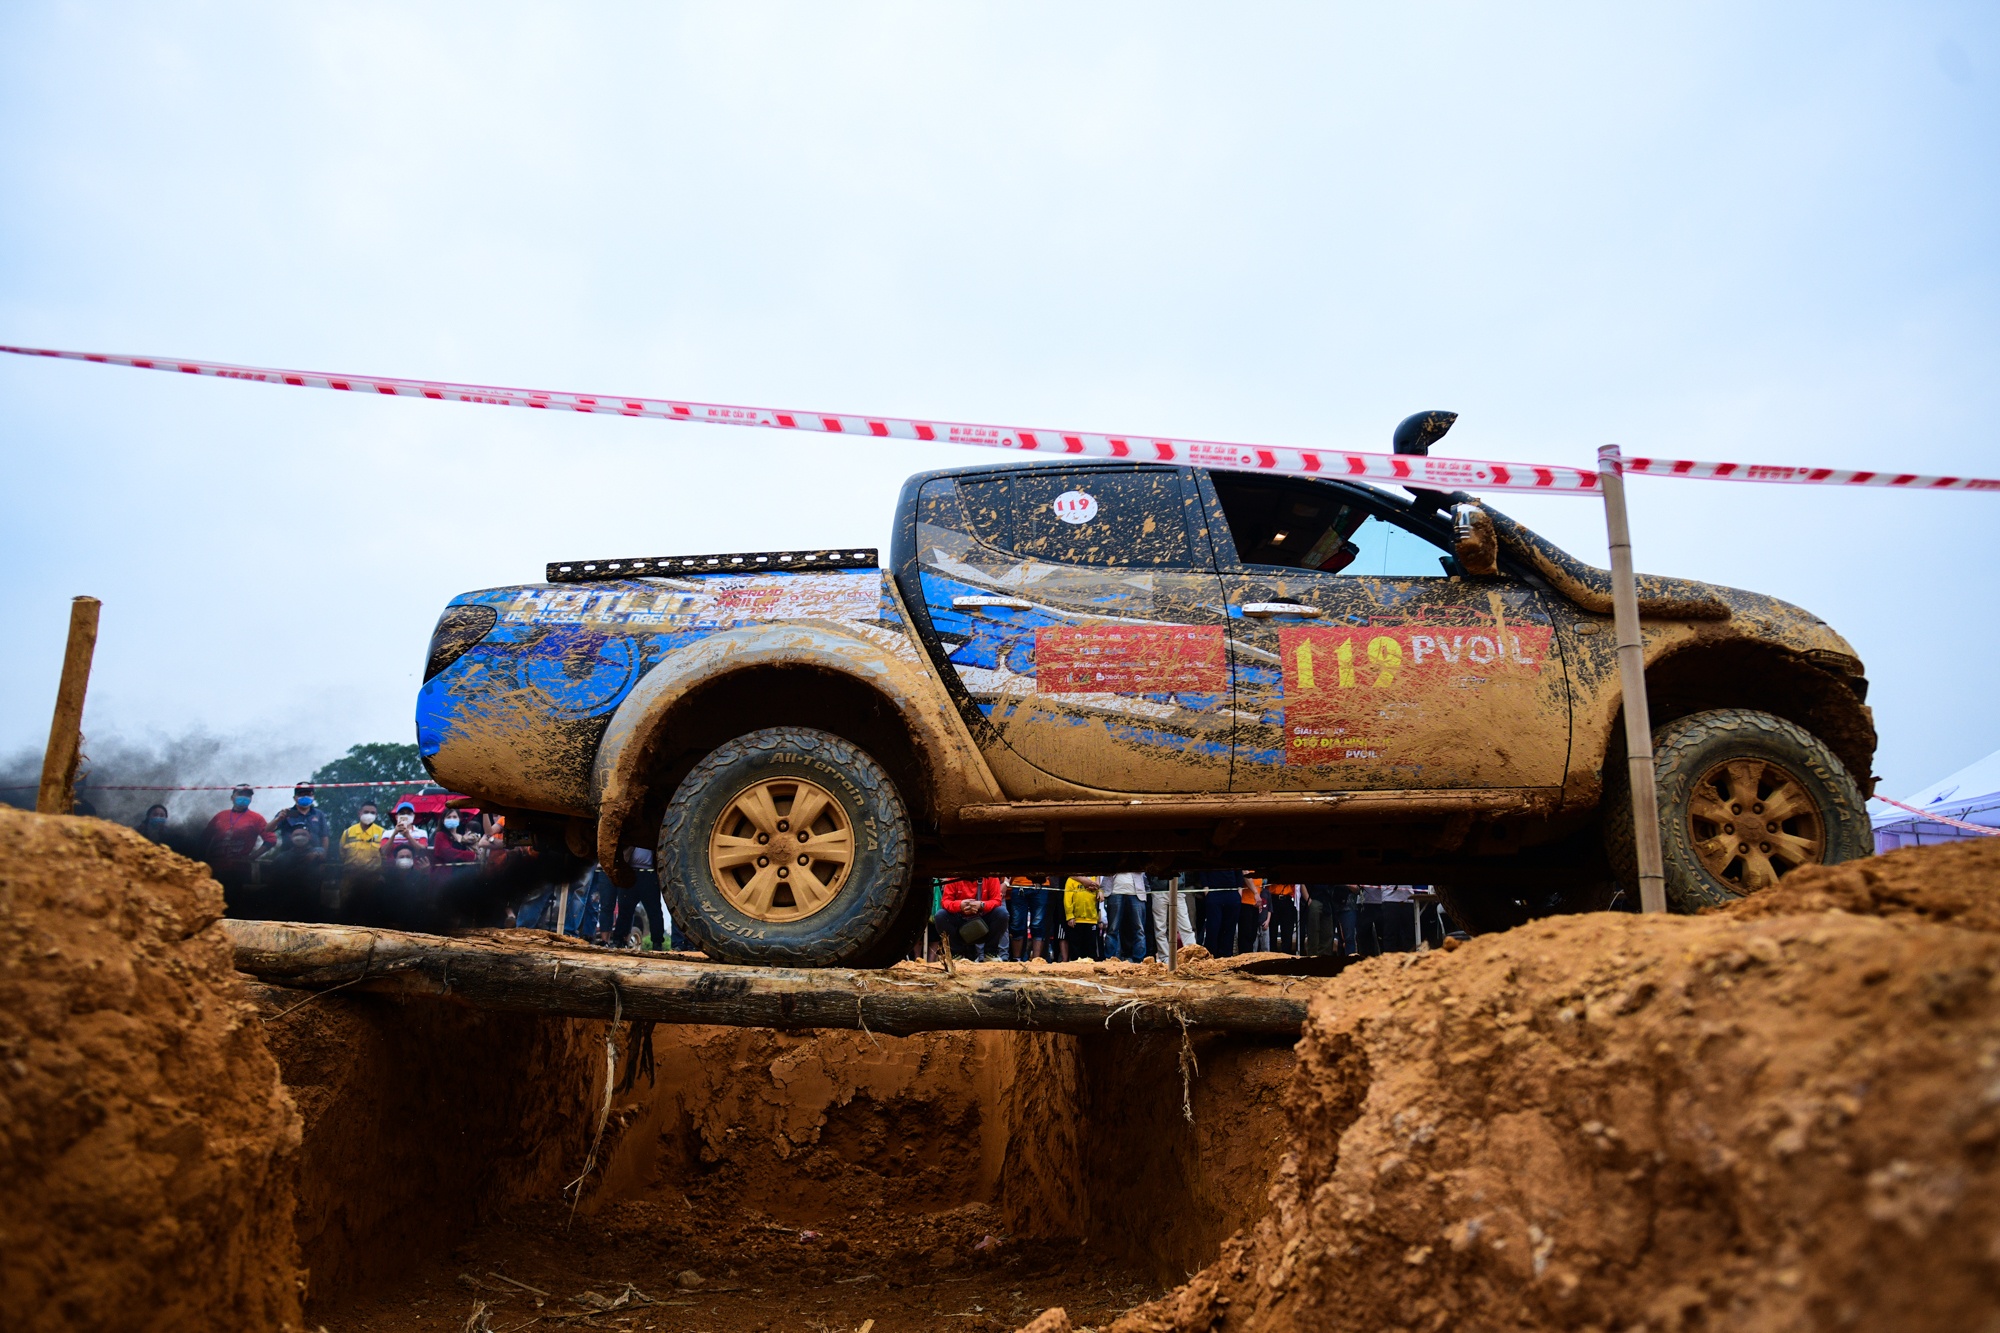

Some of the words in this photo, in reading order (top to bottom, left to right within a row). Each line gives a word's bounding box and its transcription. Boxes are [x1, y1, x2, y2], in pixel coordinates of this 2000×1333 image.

[1057, 498, 1090, 512] 119
[1293, 636, 1403, 688] 119
[1411, 636, 1534, 665] PVOIL
[770, 752, 865, 806] All-Terrain
[864, 816, 878, 851] T/A
[1804, 757, 1850, 822] YUSTA
[700, 901, 766, 940] YUSTA
